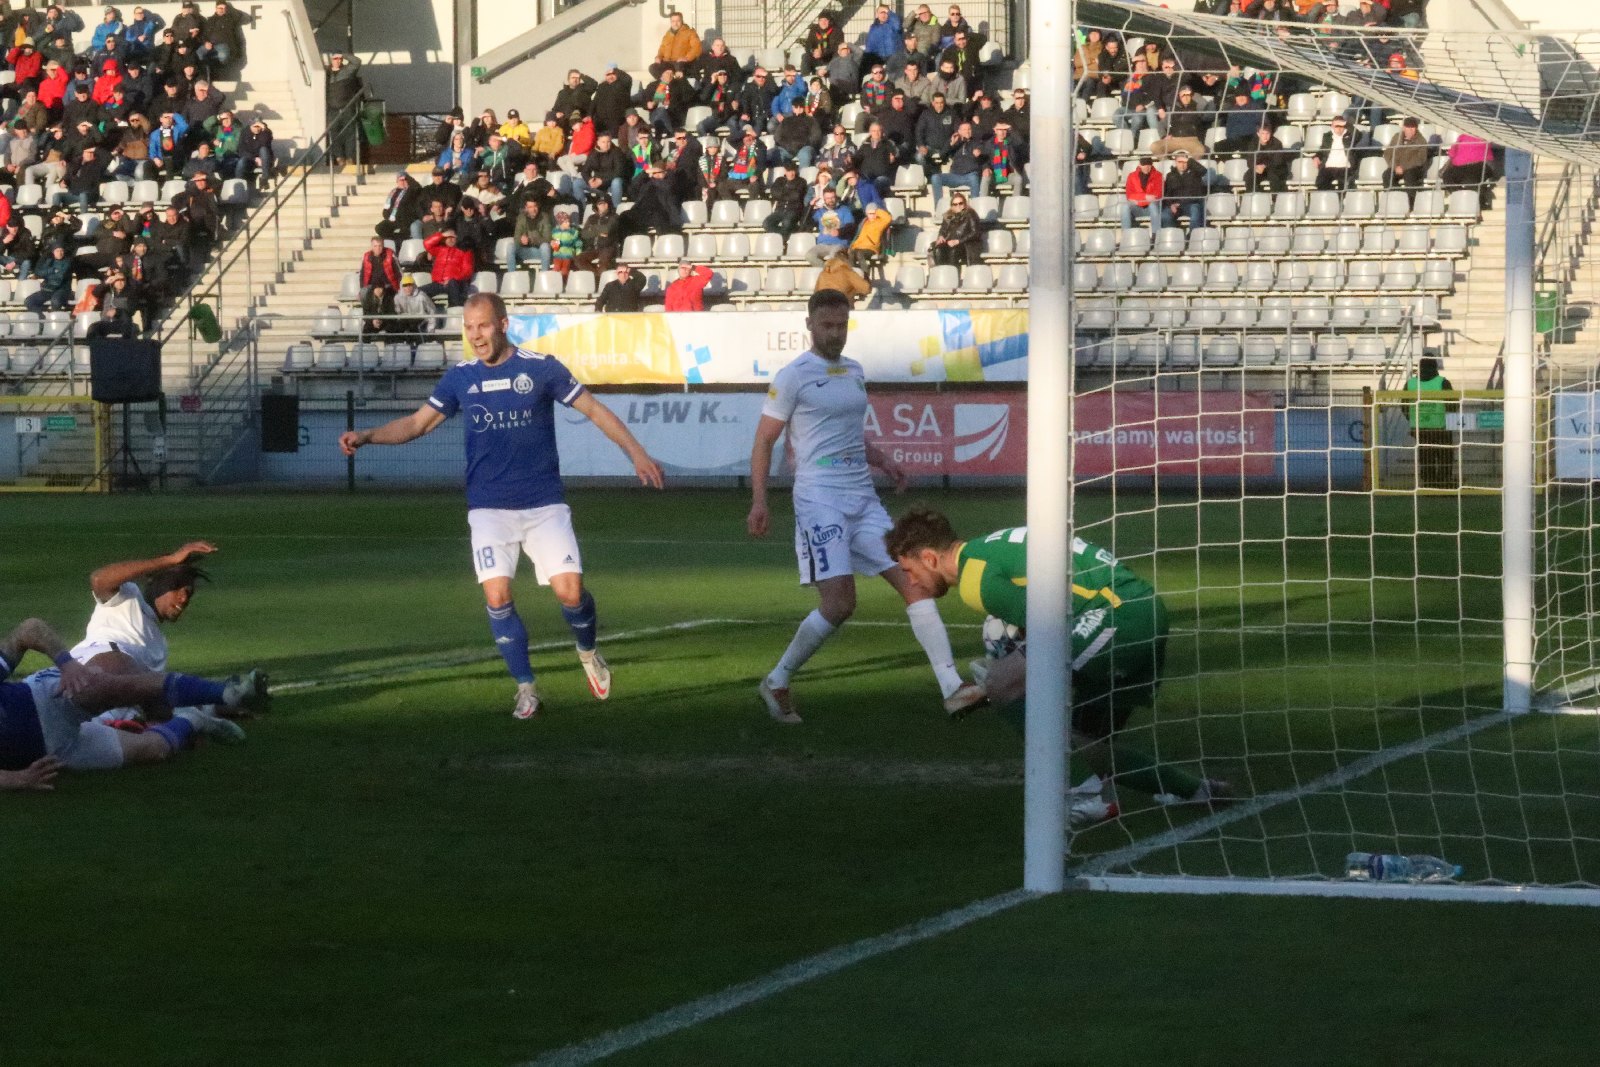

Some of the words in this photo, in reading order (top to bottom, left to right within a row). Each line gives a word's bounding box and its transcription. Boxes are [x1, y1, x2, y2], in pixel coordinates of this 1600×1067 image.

[250, 4, 263, 30] F
[767, 331, 814, 351] LEGN
[25, 418, 33, 432] 3
[472, 409, 532, 424] VOTUM
[492, 419, 532, 430] ENERGY
[893, 404, 943, 437] SA
[1164, 425, 1254, 445] wartości
[893, 450, 943, 465] Group
[816, 527, 838, 542] LOTTO
[475, 546, 496, 571] 18
[816, 546, 830, 573] 3
